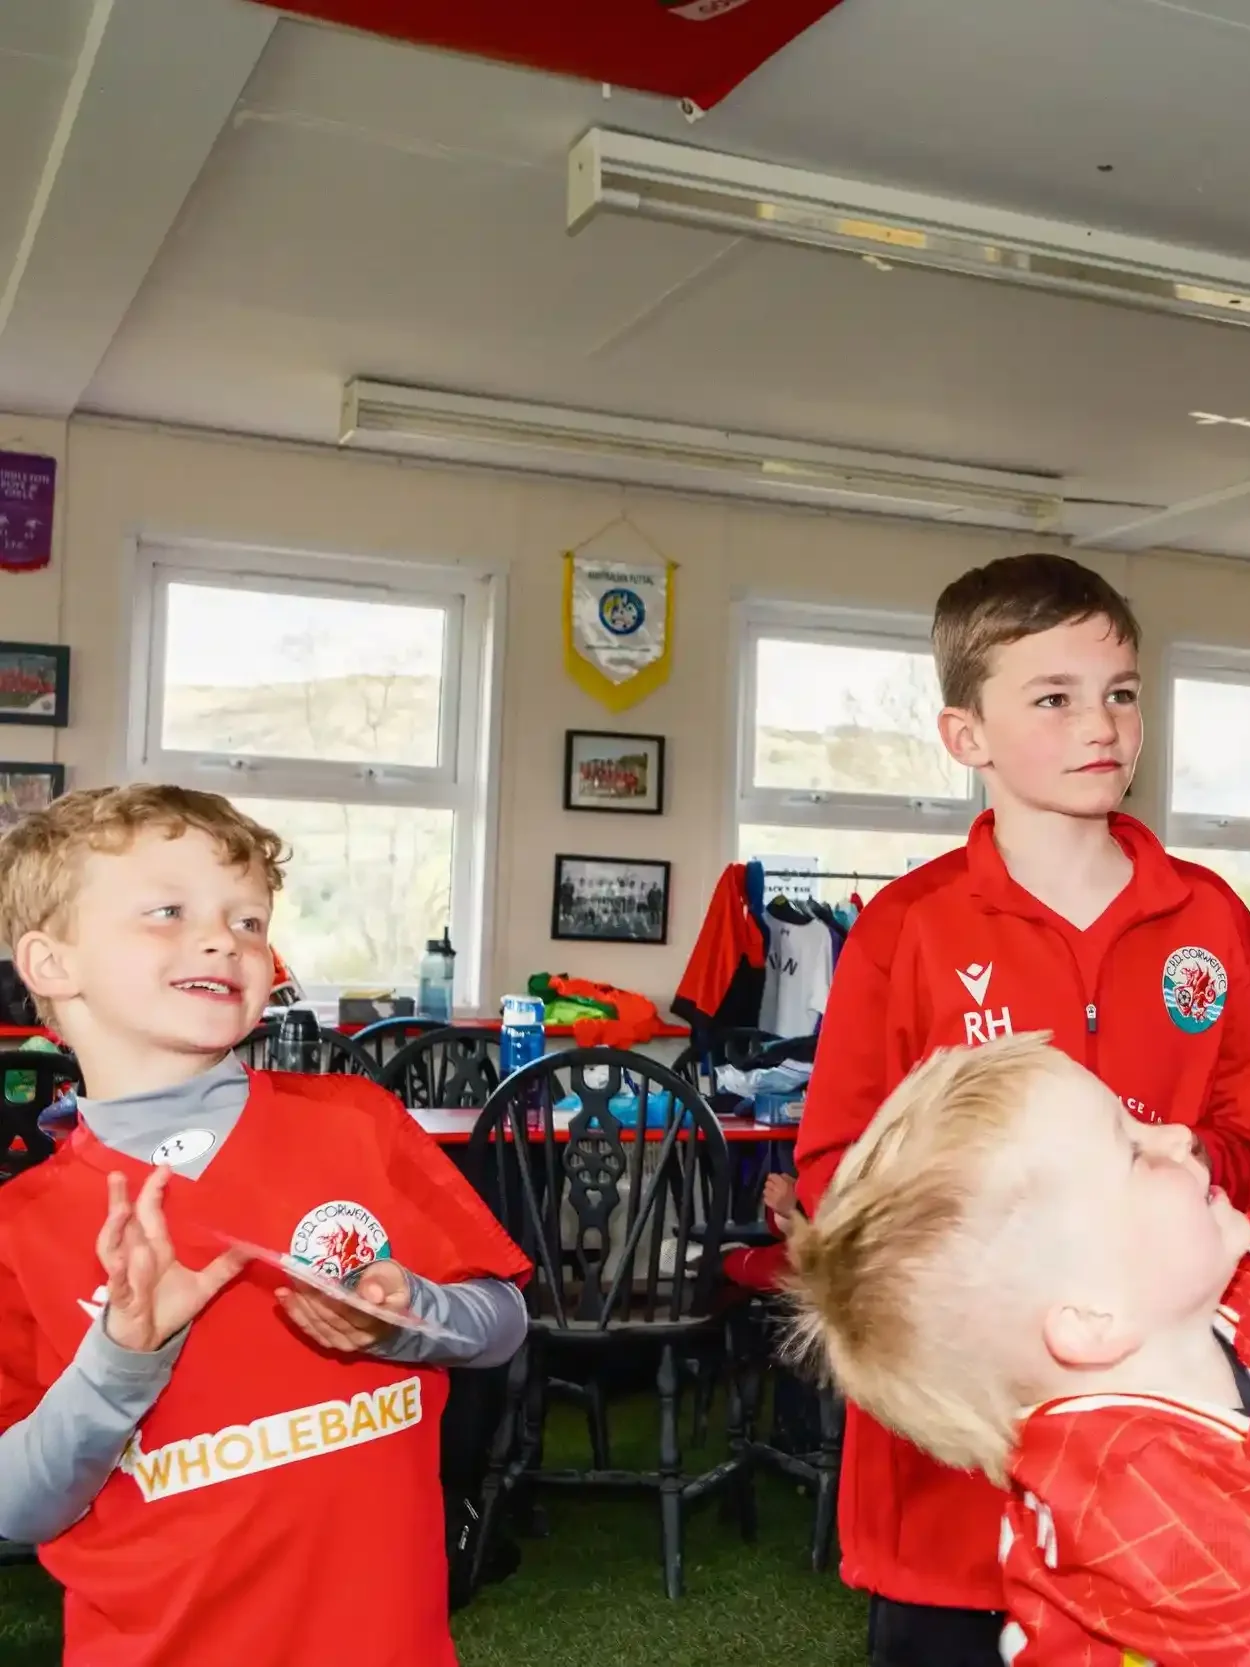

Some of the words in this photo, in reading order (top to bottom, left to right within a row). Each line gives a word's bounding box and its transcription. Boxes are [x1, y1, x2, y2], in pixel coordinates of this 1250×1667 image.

[1181, 948, 1222, 973] CORWEN
[963, 1006, 1014, 1045] RH
[315, 1203, 370, 1225] CORWEN
[136, 1383, 417, 1494] WHOLEBAKE
